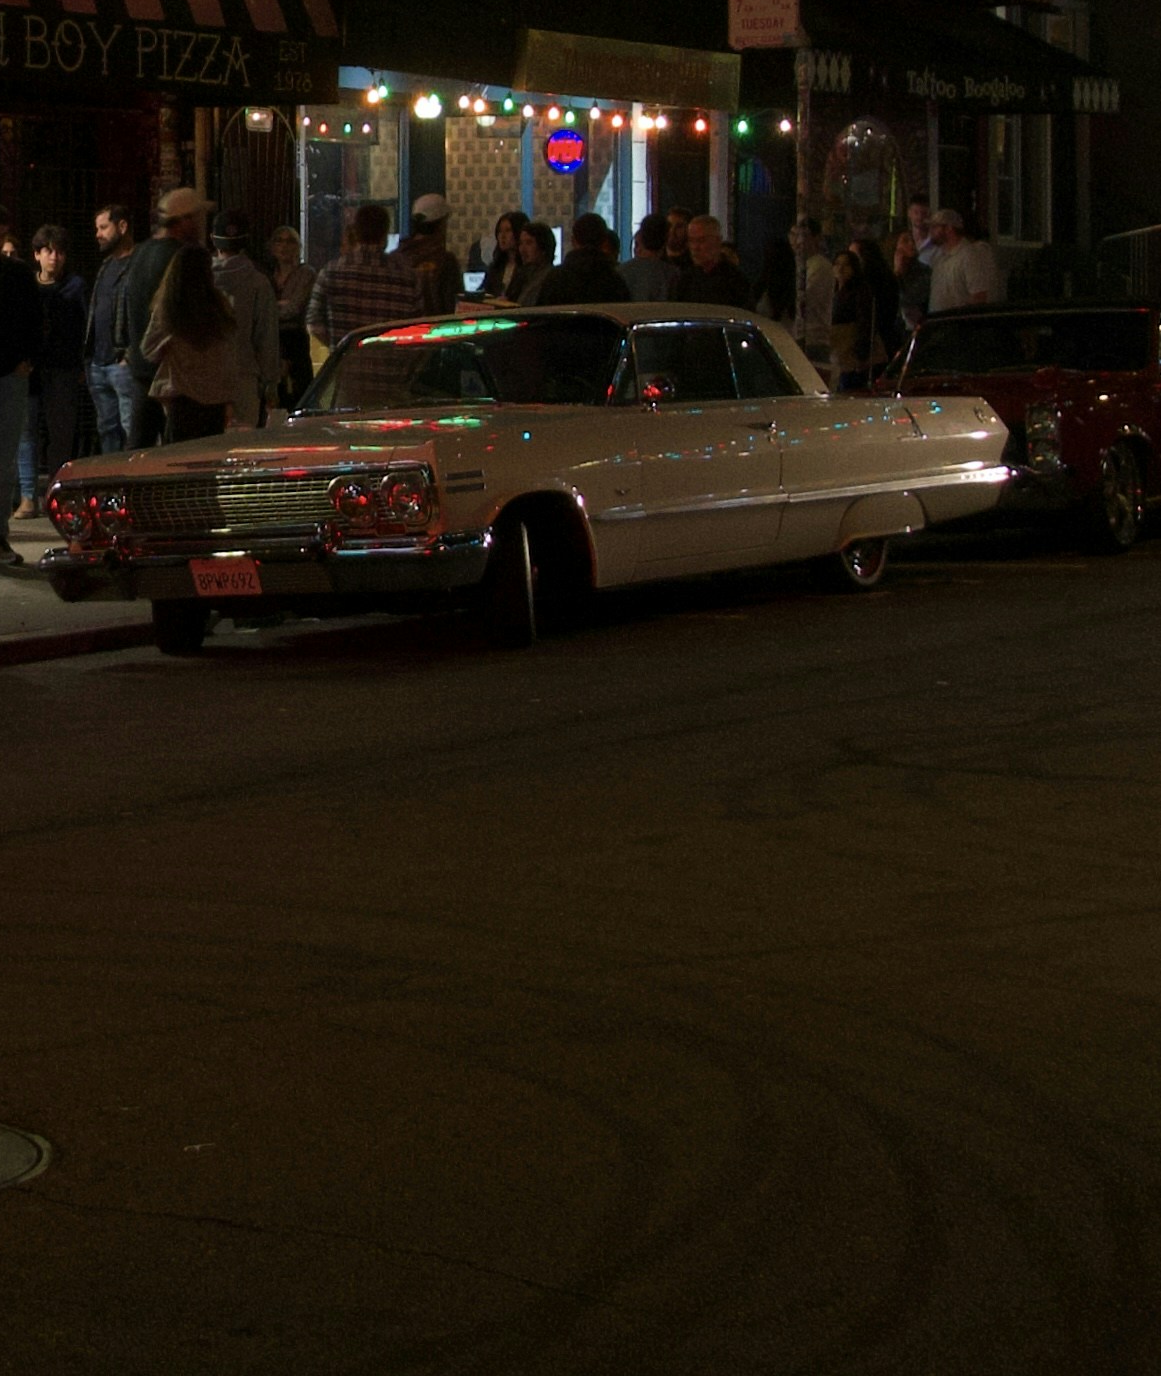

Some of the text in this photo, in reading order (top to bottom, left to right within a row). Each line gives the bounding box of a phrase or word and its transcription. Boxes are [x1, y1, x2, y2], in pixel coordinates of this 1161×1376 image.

[742, 17, 784, 30] TUESDAY
[23, 14, 124, 76] BOY
[134, 26, 250, 87] PIZZA
[279, 39, 308, 63] EST
[907, 65, 957, 99] Tattoo
[964, 76, 1025, 106] Boogaloo
